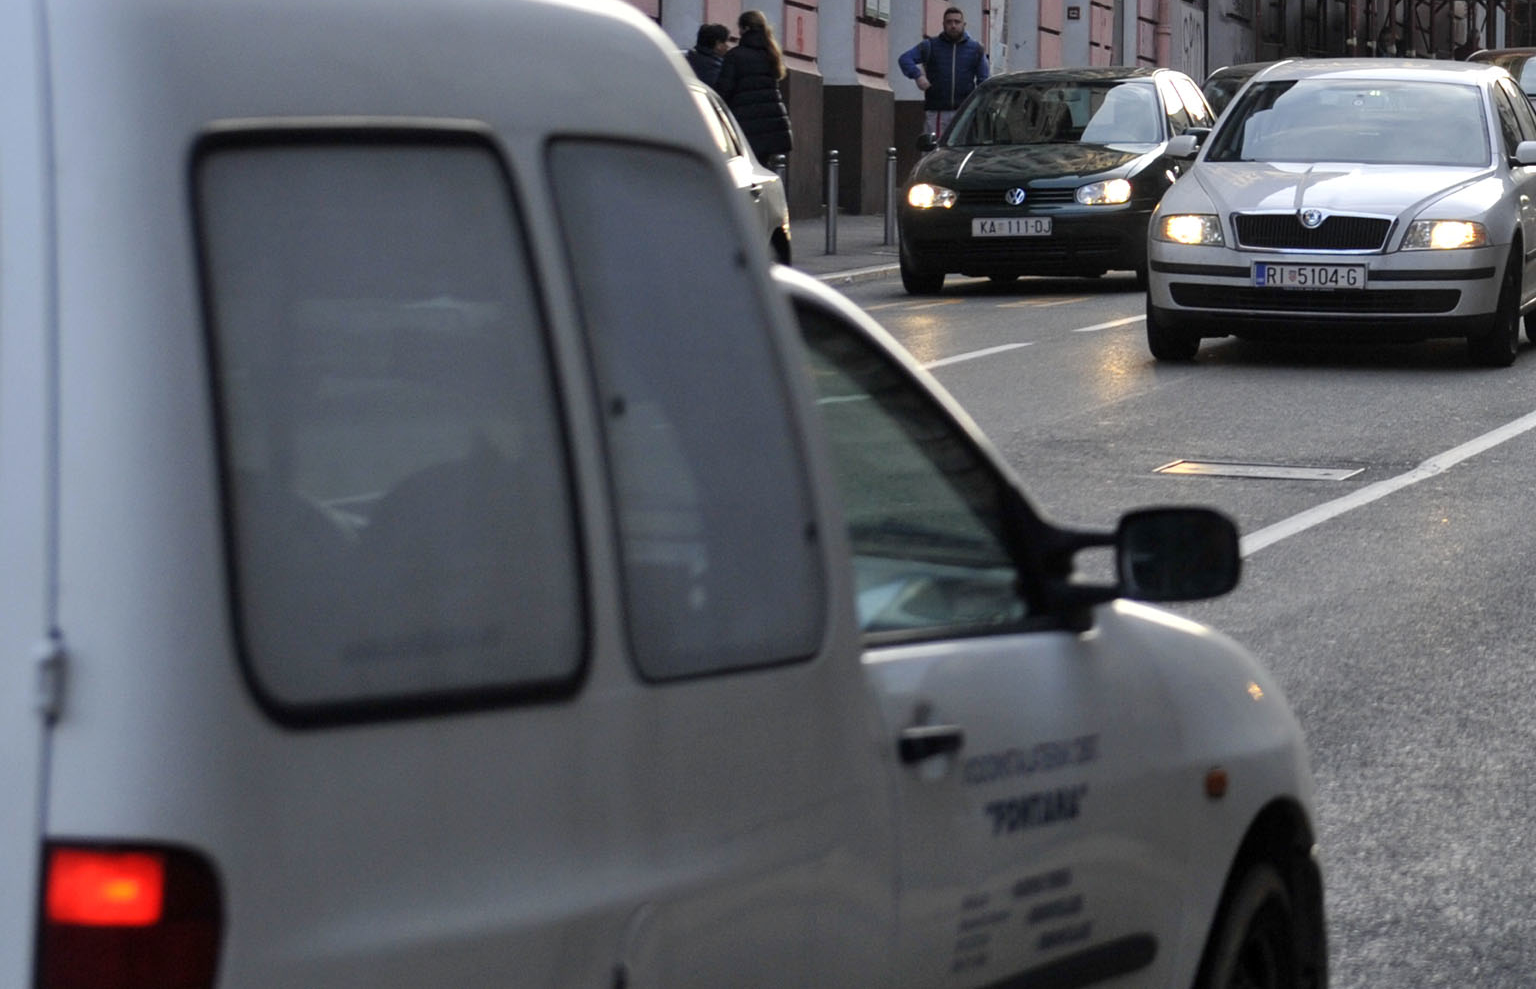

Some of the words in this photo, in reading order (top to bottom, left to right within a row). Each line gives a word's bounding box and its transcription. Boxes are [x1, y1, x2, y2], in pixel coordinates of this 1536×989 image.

[980, 221, 996, 235] KA
[1266, 266, 1284, 284] RI
[1298, 267, 1357, 286] 5104-G
